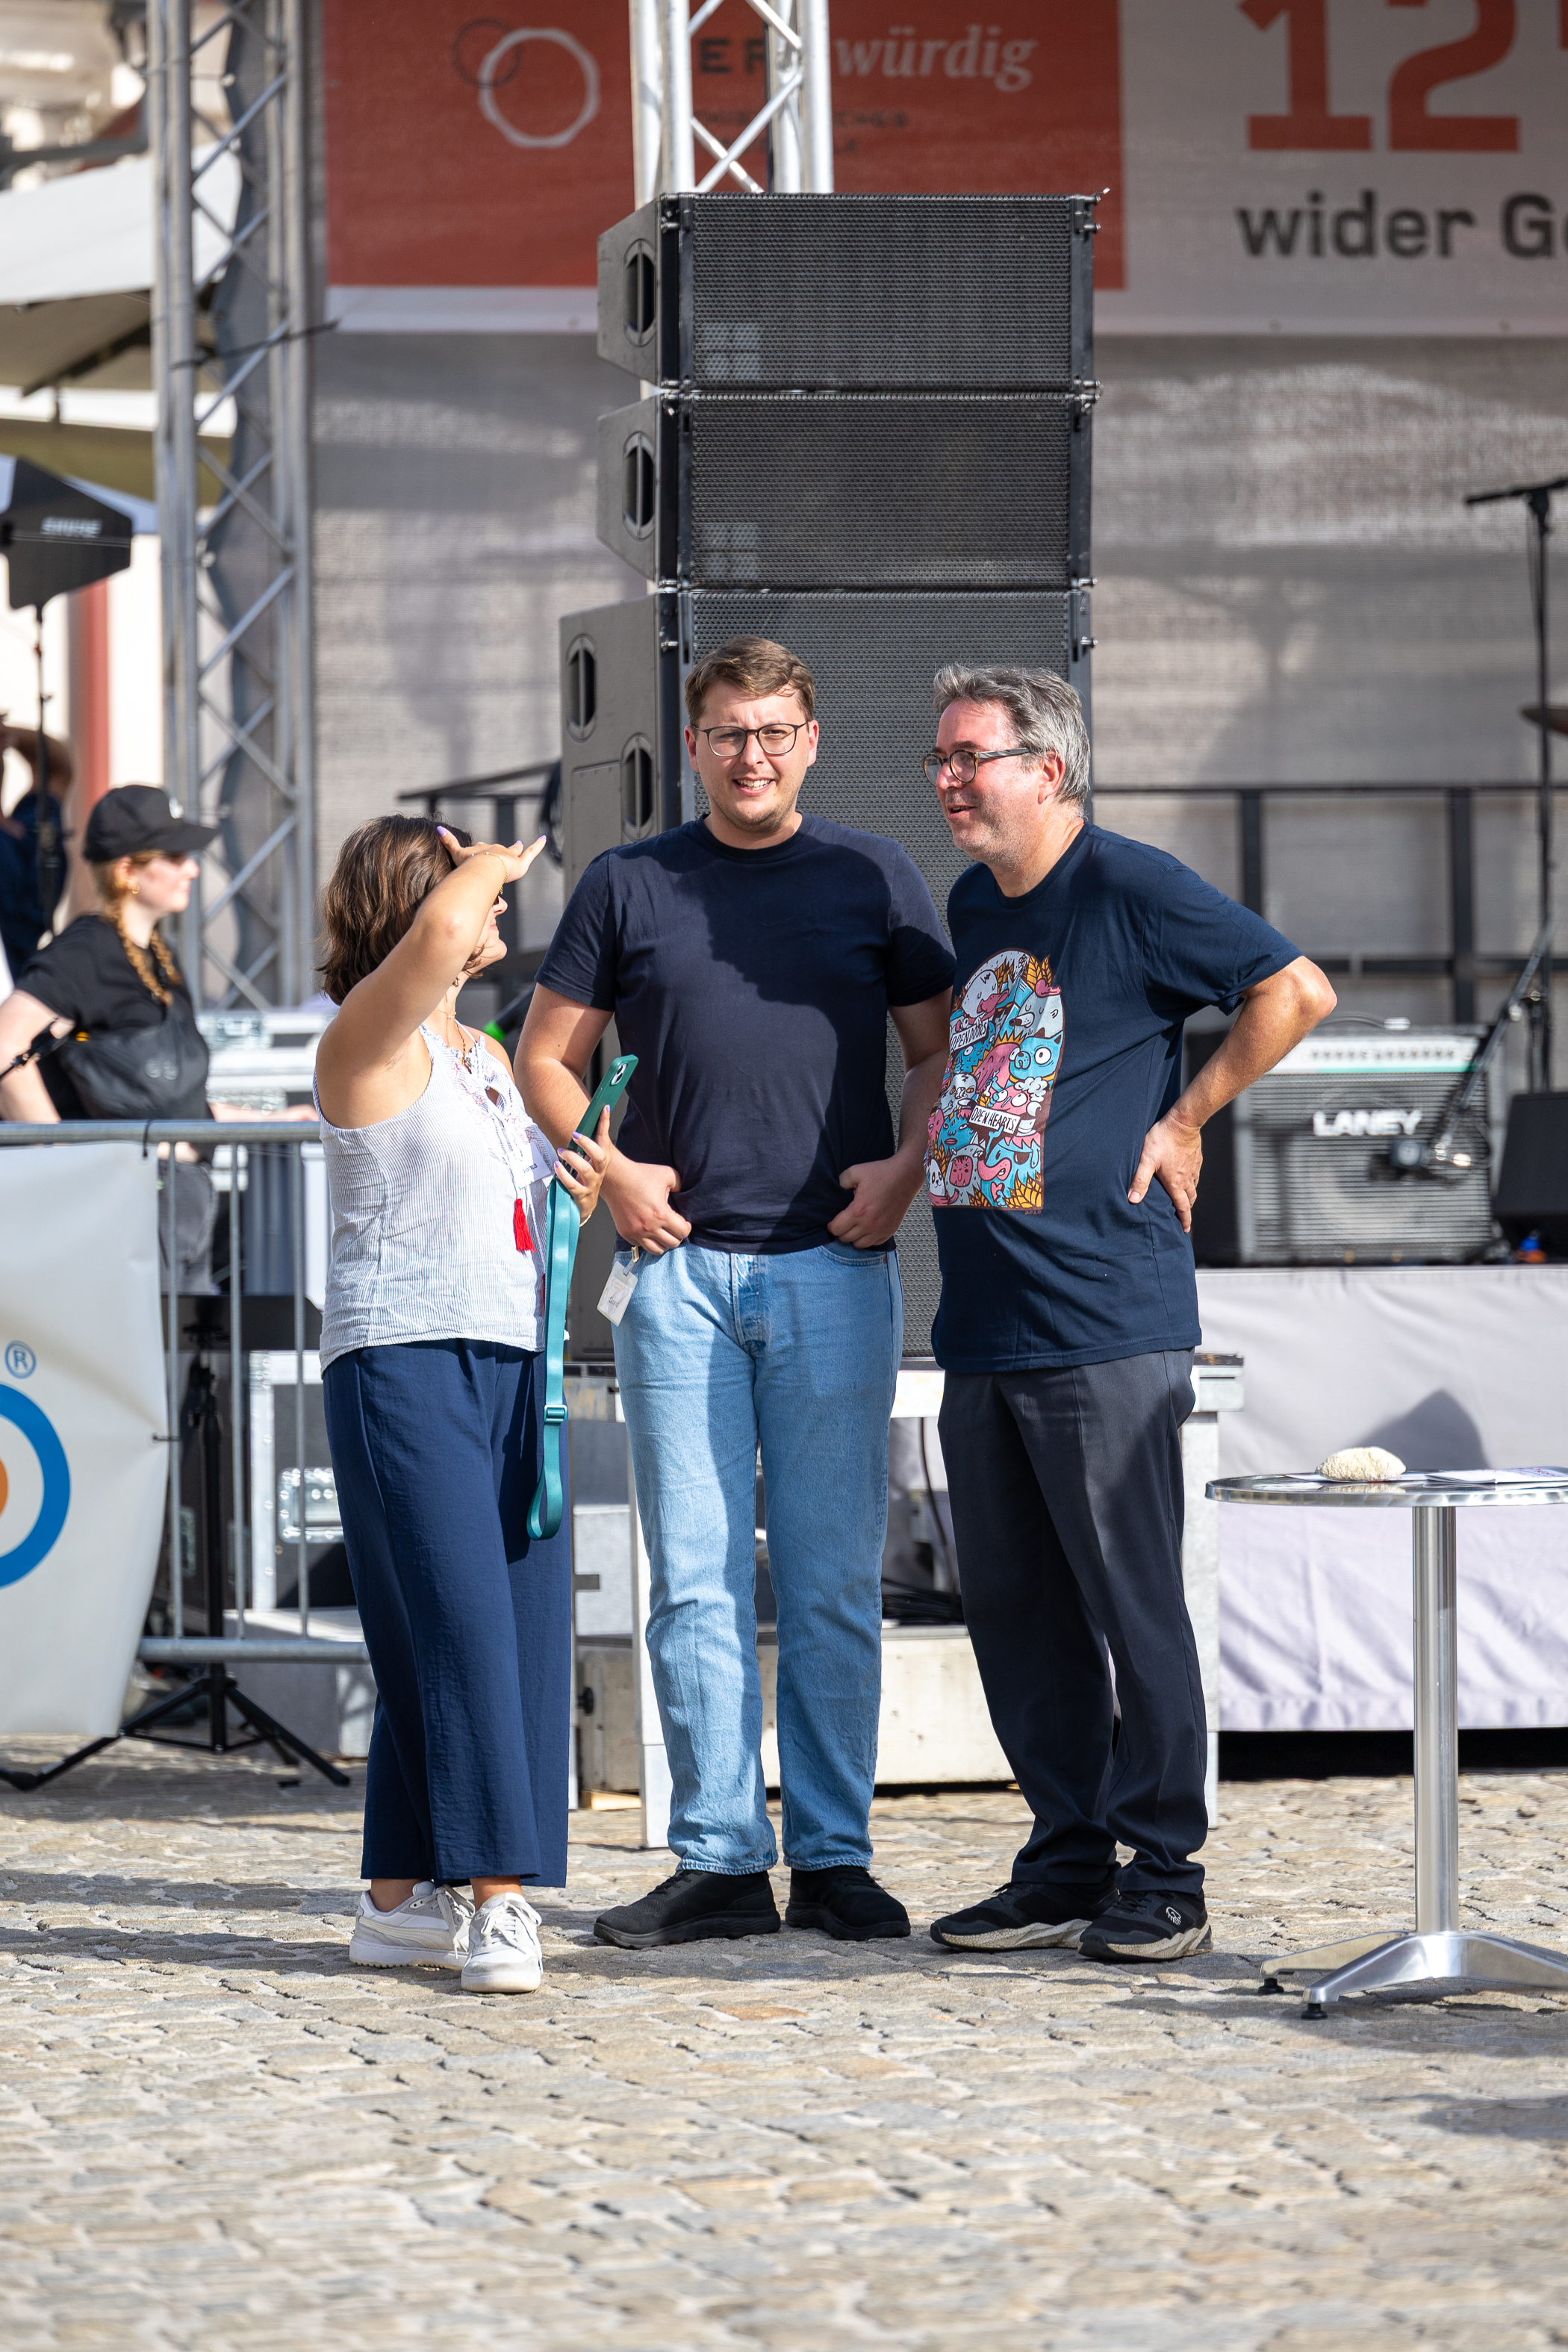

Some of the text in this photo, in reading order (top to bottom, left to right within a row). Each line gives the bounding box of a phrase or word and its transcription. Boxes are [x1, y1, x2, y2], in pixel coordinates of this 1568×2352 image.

[1237, 0, 1568, 152] 12
[1236, 190, 1568, 259] wider G
[951, 1022, 987, 1048] OPEN DOORS
[971, 1107, 990, 1124] OPEN
[1313, 1110, 1422, 1136] LANEY
[523, 1163, 538, 1173] ianca
[609, 1296, 619, 1307] David
